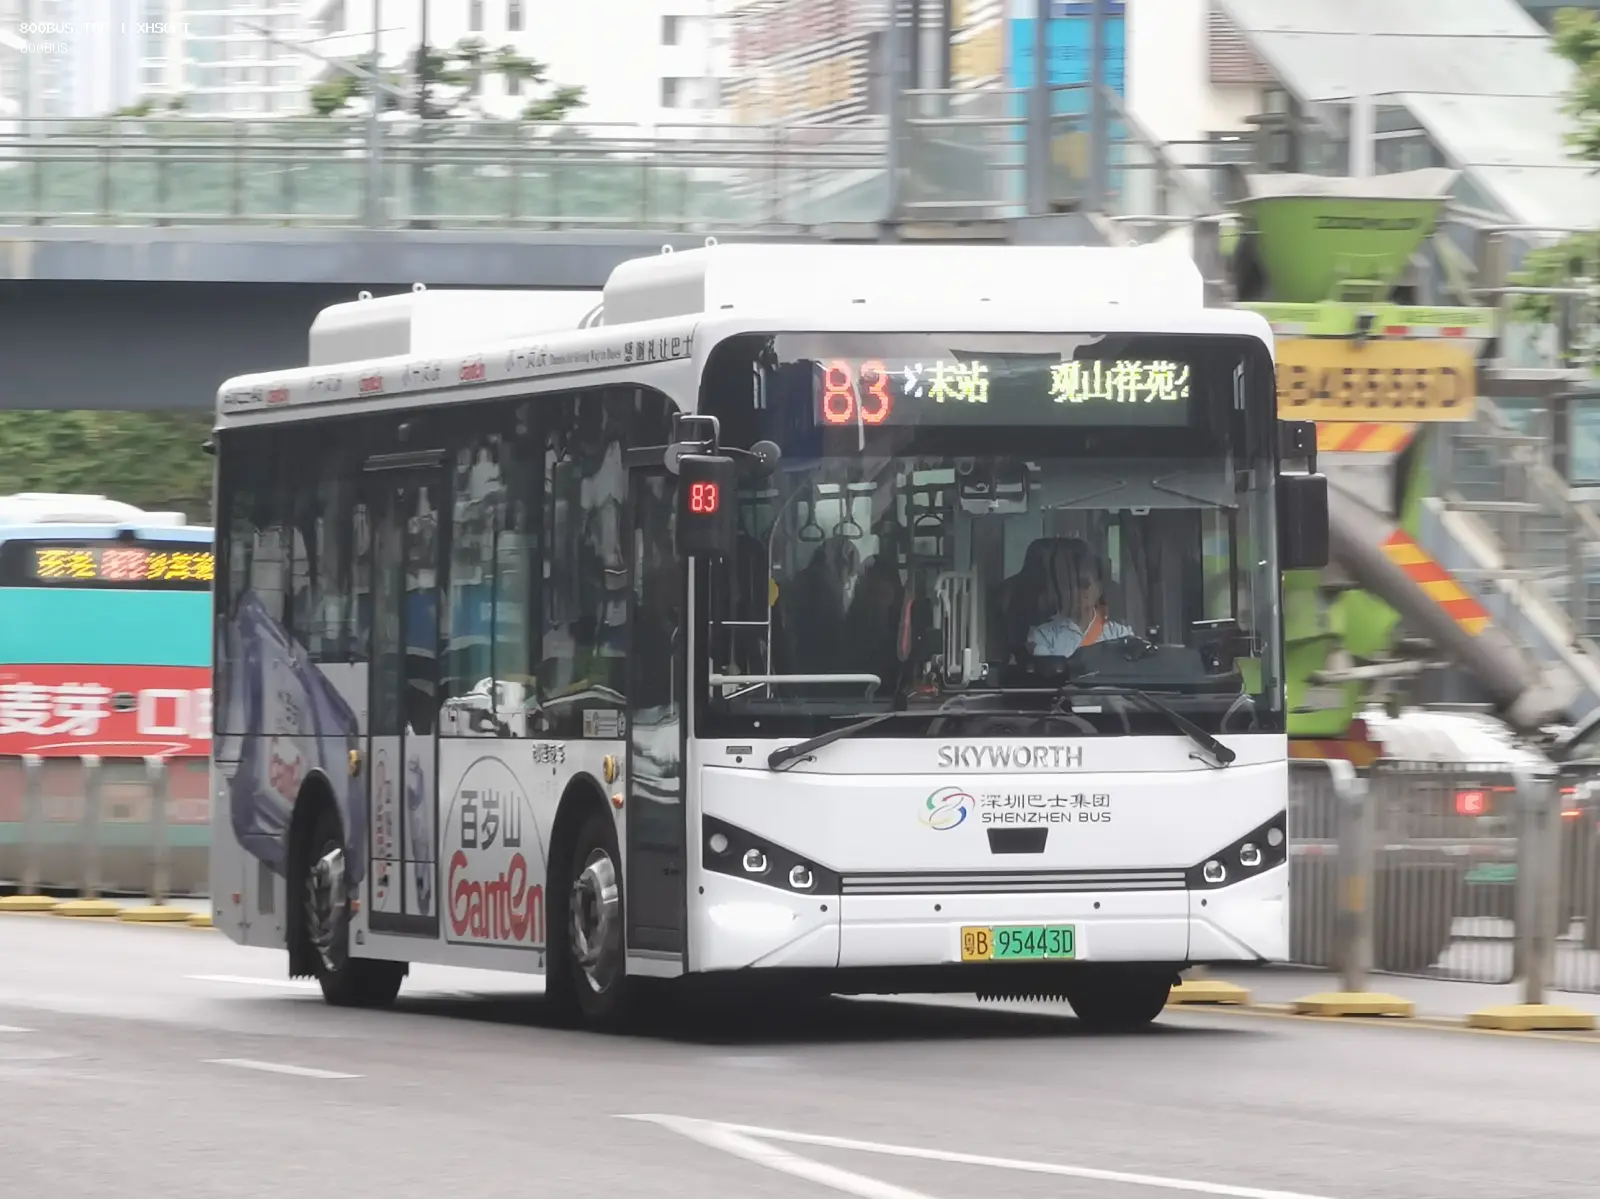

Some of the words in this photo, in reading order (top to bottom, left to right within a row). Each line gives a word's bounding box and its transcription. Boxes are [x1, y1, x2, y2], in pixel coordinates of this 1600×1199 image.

[823, 360, 890, 424] 83
[691, 484, 716, 512] 83
[937, 745, 1083, 768] SKYWORTH
[980, 793, 1110, 809] 深圳巴士集团
[461, 788, 521, 850] 百岁山
[981, 812, 1072, 823] SHENZHEN
[1078, 811, 1112, 823] BUS
[448, 850, 545, 944] Ganten
